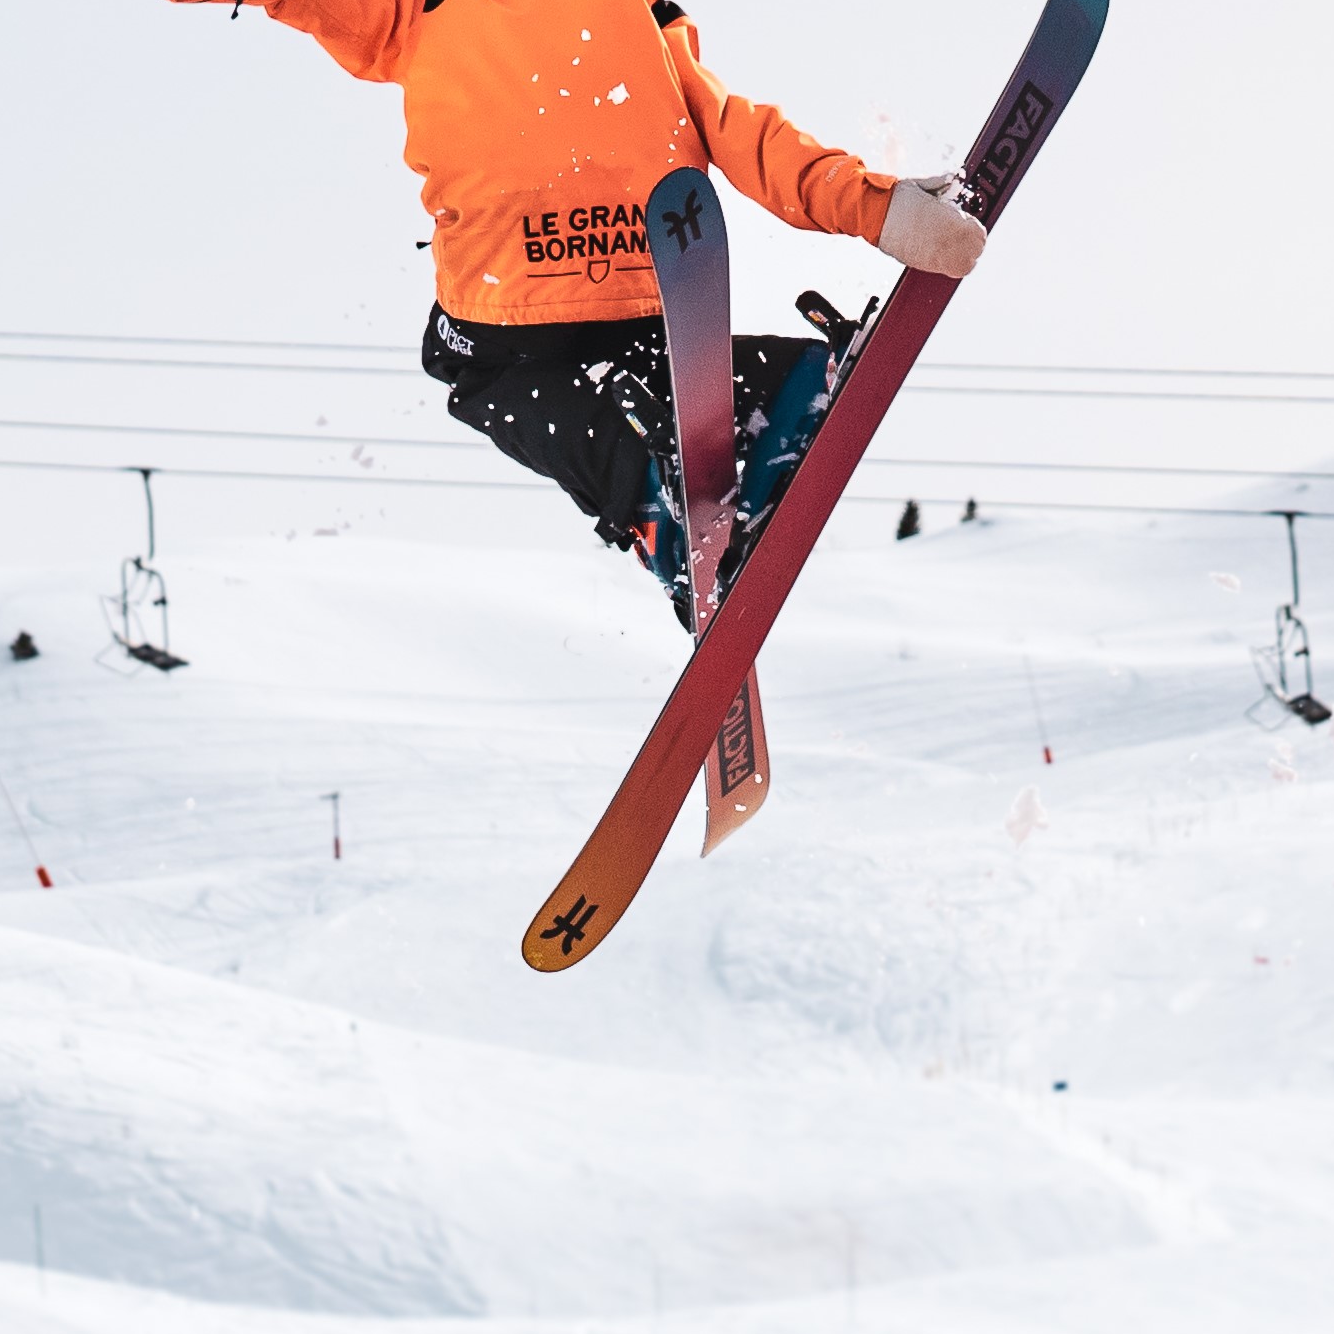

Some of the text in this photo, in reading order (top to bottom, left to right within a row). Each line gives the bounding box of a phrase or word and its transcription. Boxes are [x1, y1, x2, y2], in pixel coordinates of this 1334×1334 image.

[523, 212, 560, 238] LE
[525, 230, 650, 263] BORNAN
[723, 688, 749, 787] FACTIO
